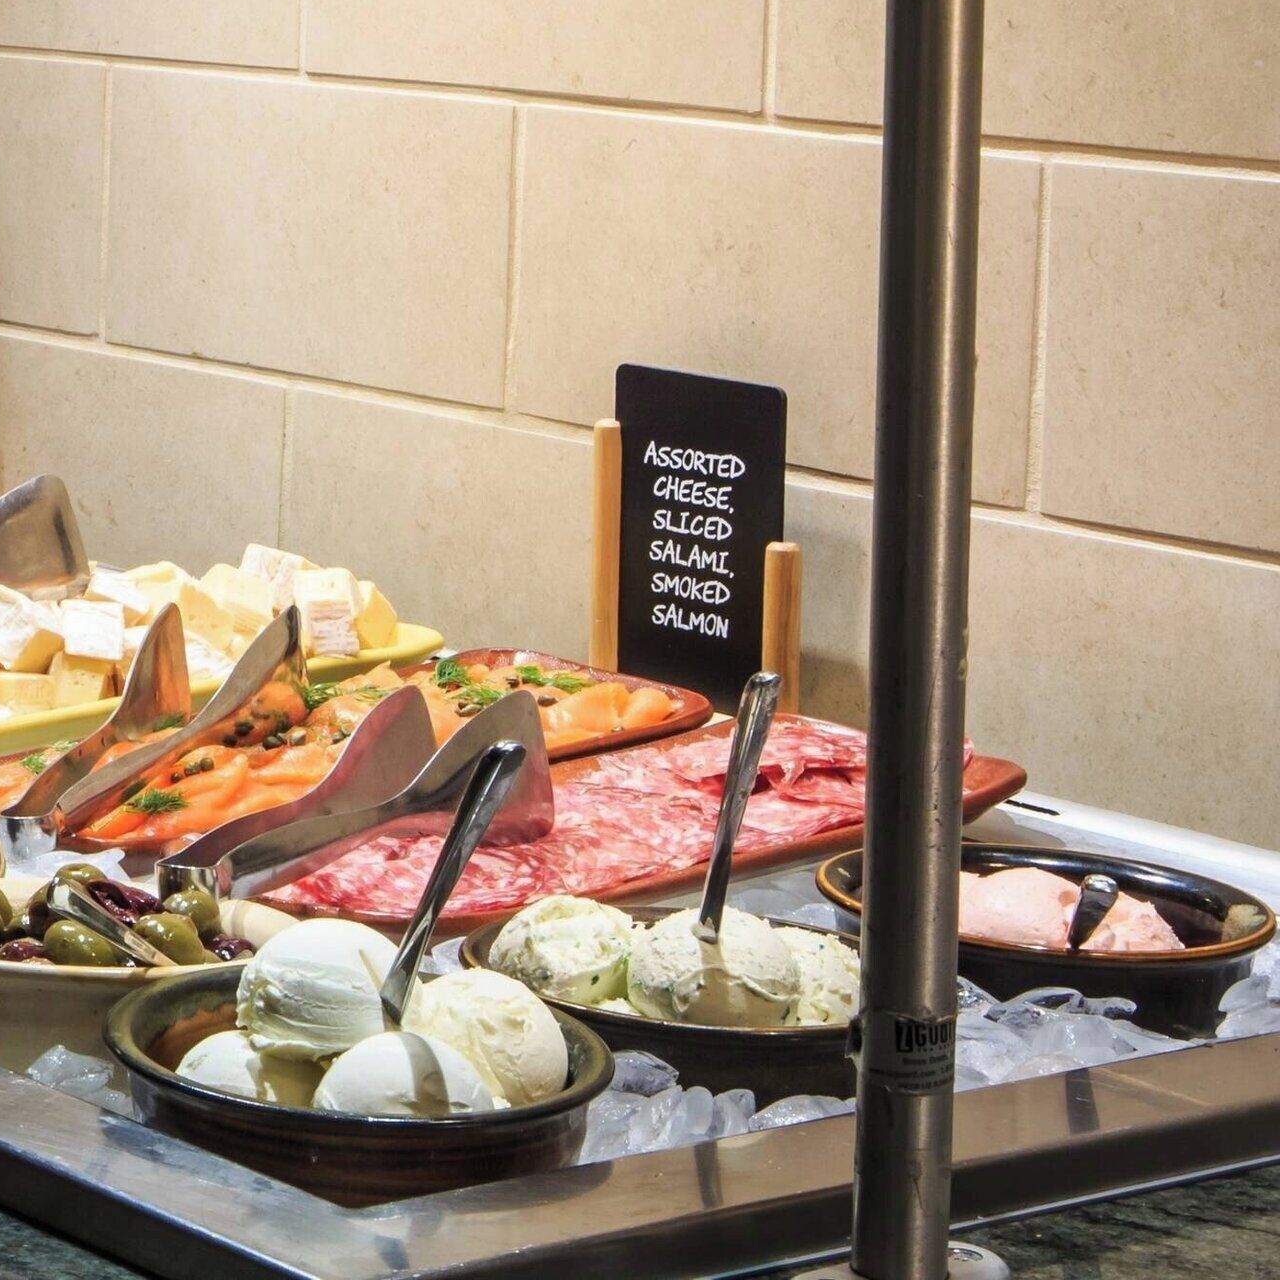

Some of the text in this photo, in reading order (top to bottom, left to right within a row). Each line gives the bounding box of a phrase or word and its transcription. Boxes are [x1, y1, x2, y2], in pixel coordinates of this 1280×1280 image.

[643, 440, 745, 479] ASSORTED
[653, 475, 734, 513] CHEESE,
[652, 509, 733, 541] SLICED
[649, 539, 734, 578] SALAMI,
[651, 573, 731, 605] SMOKED
[652, 604, 729, 639] SALMON
